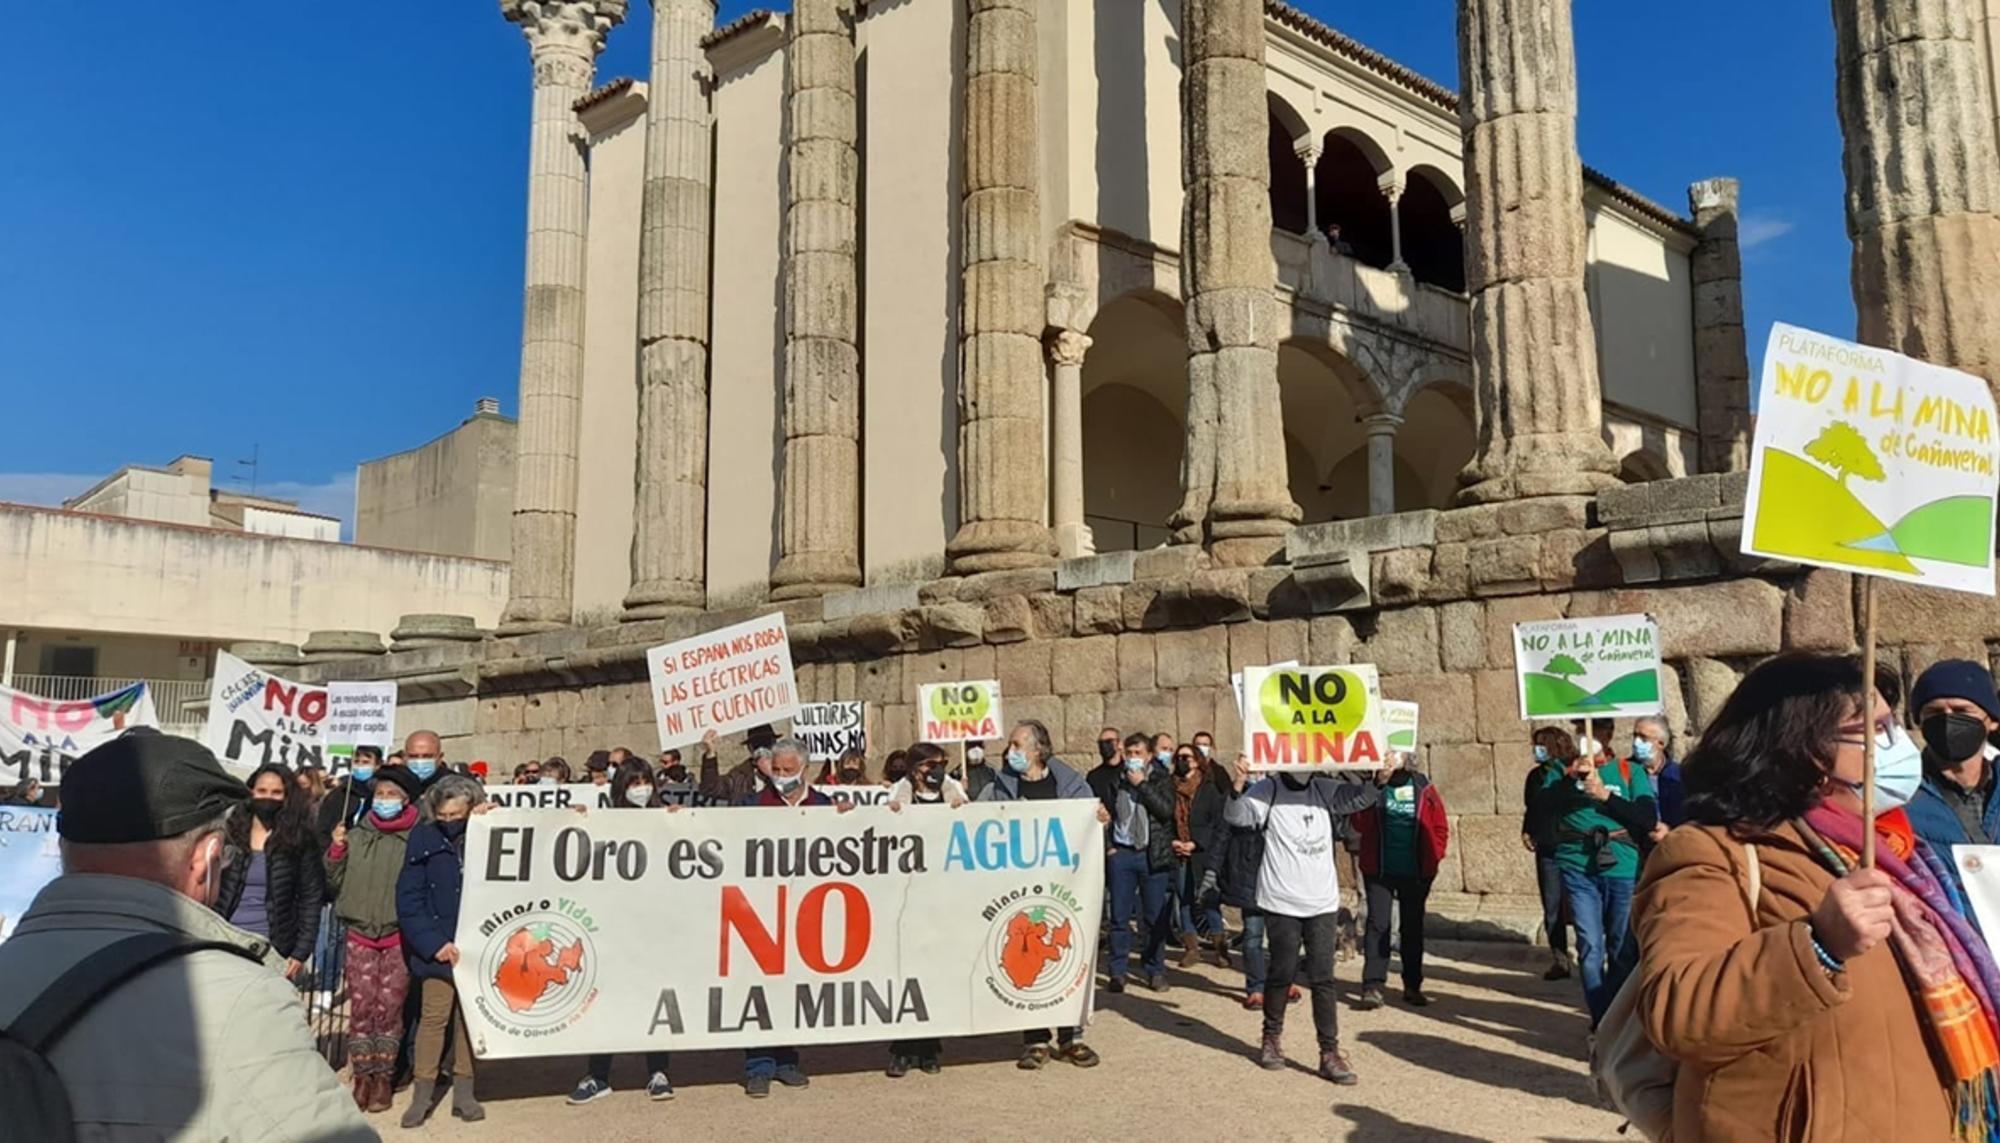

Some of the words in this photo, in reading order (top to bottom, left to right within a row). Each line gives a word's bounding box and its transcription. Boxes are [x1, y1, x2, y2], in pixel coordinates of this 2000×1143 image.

[1779, 334, 1885, 373] PLATAFORMA
[1774, 361, 1832, 405] NO
[1842, 376, 1858, 414] A
[1869, 380, 1904, 424] LA
[1912, 394, 1991, 444] MINA
[1879, 428, 1900, 459] de
[1904, 432, 1993, 476] Cañaveral
[1520, 622, 1578, 634] PLATAFORMA
[1522, 635, 1549, 651] NO
[1558, 633, 1567, 650] A
[1573, 632, 1594, 648] LA
[1602, 628, 1652, 647] MINA
[663, 656, 677, 675] SI
[731, 635, 753, 655] NOS
[753, 626, 786, 649] ROBA
[1581, 653, 1594, 664] de
[1597, 648, 1655, 661] Cañaveral
[662, 682, 688, 706] LAS
[692, 655, 781, 698] ELÉCTRICAS
[941, 685, 979, 705] NO
[1279, 673, 1347, 705] NO
[10, 694, 94, 733] NO
[264, 677, 328, 722] NO
[948, 707, 957, 716] A
[960, 706, 973, 716] LA
[276, 718, 286, 730] A
[290, 722, 317, 736] LAS
[666, 712, 683, 736] NI
[688, 704, 706, 729] TE
[927, 717, 996, 739] MINA
[1292, 710, 1306, 724] A
[1312, 710, 1337, 725] LA
[22, 733, 38, 745] A
[795, 730, 848, 754] MINAS
[1252, 731, 1380, 764] MINA
[485, 826, 534, 881] El
[553, 827, 648, 881] Oro
[669, 839, 723, 879] es
[745, 826, 927, 877] nuestra
[944, 817, 1080, 873] AGUA,
[479, 901, 533, 937] Minas
[540, 899, 550, 910] o
[558, 898, 599, 932] Vidas
[982, 887, 1027, 922] Minas
[1033, 884, 1043, 894] o
[1050, 882, 1083, 913] Vidas
[719, 881, 871, 976] NO
[648, 988, 685, 1035] A
[707, 984, 773, 1031] LA
[795, 978, 930, 1030] MINA
